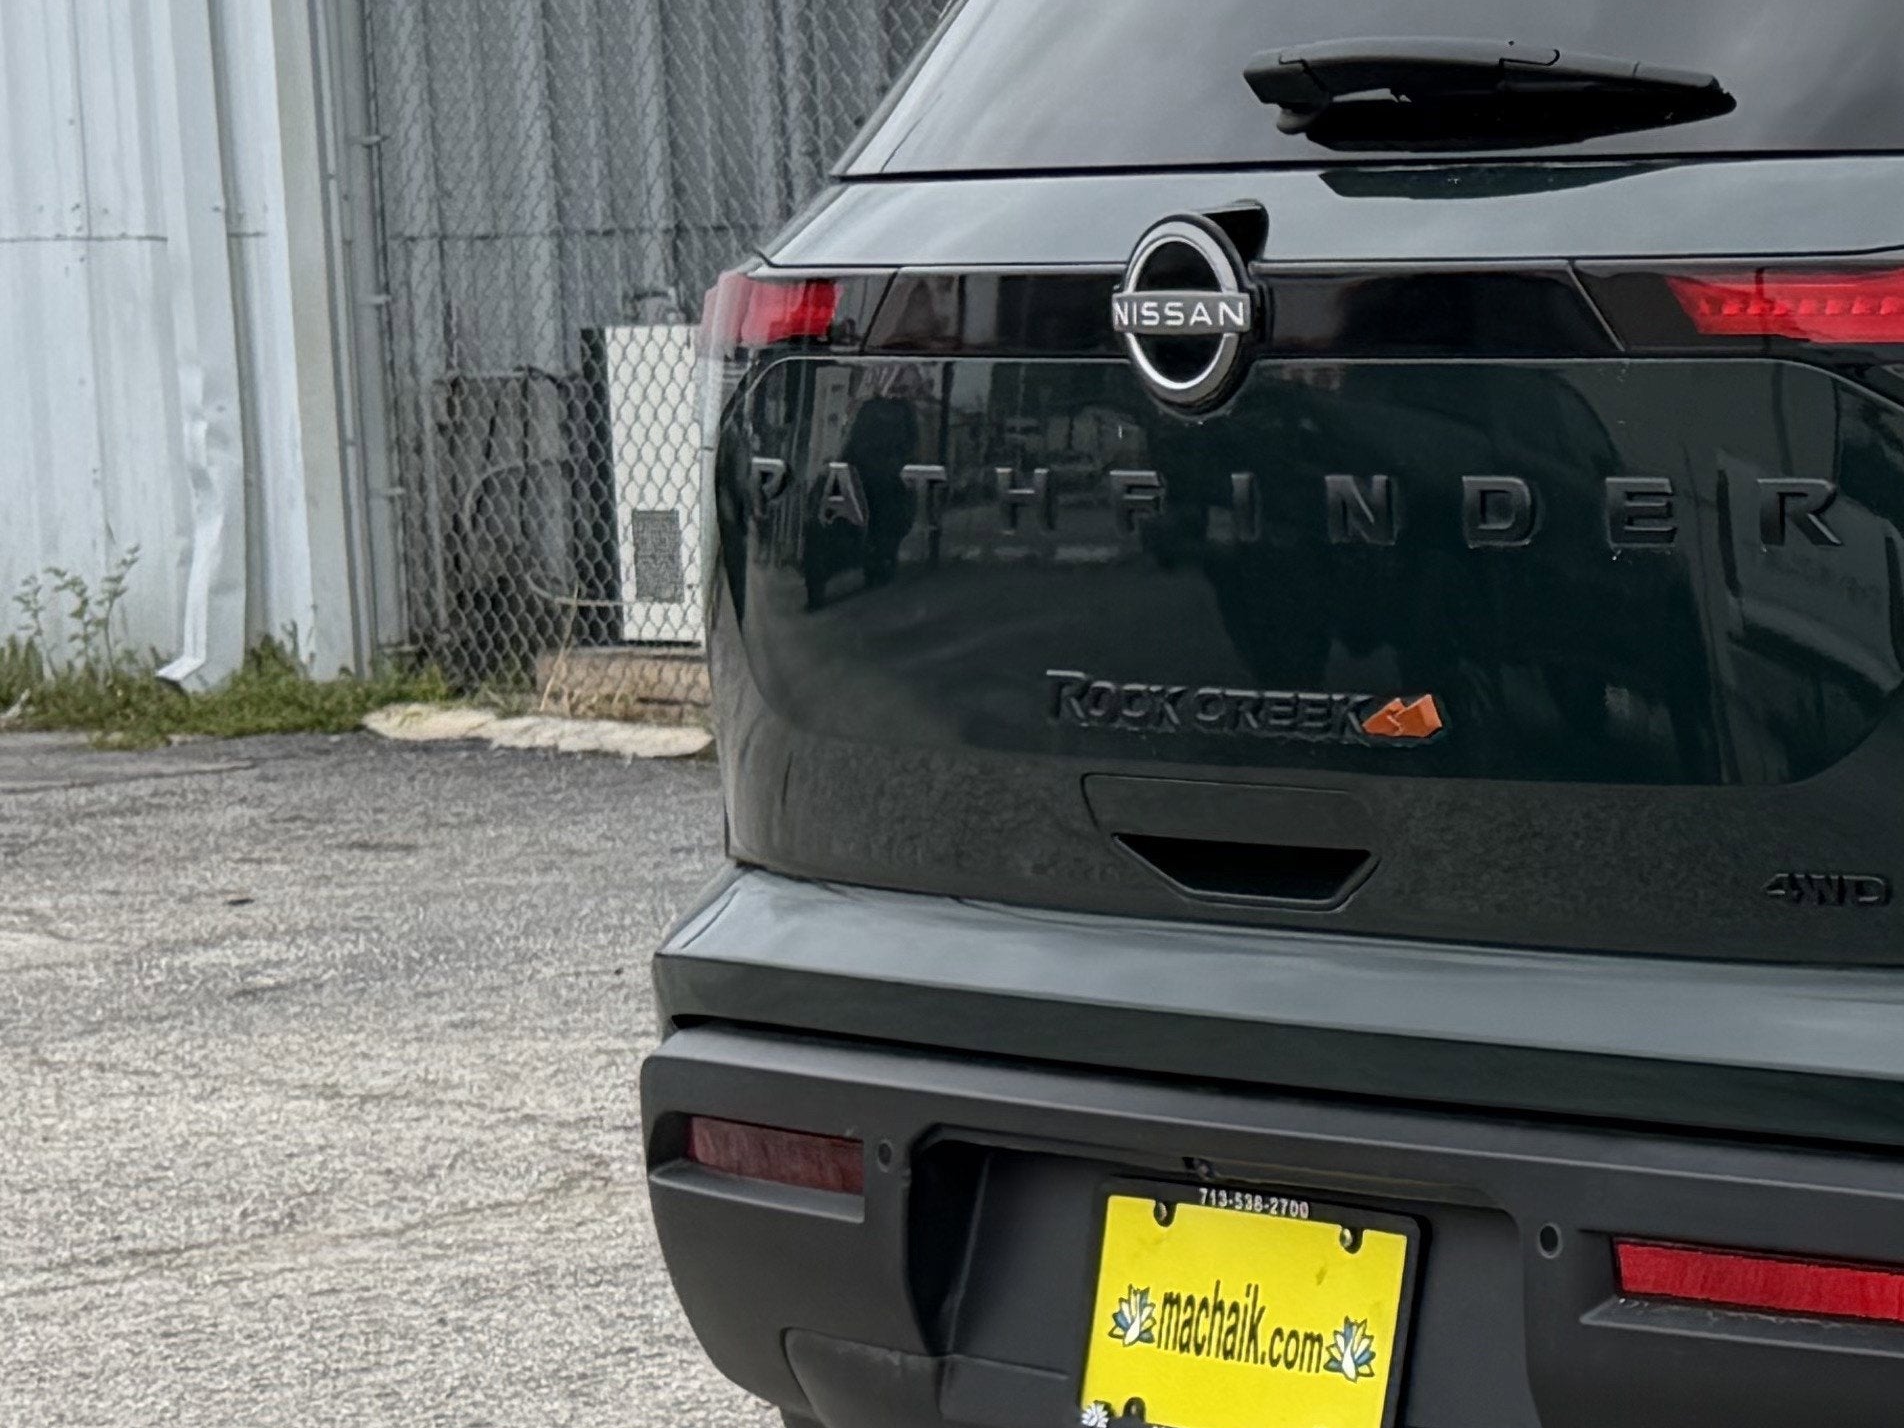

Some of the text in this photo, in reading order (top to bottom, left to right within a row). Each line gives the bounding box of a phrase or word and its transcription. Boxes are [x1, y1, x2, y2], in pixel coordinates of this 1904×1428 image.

[1113, 301, 1244, 327] NISSAN
[748, 455, 1842, 552] PATHFINDER
[1760, 873, 1892, 906] 4WD
[1157, 1278, 1324, 1374] machaik.com
